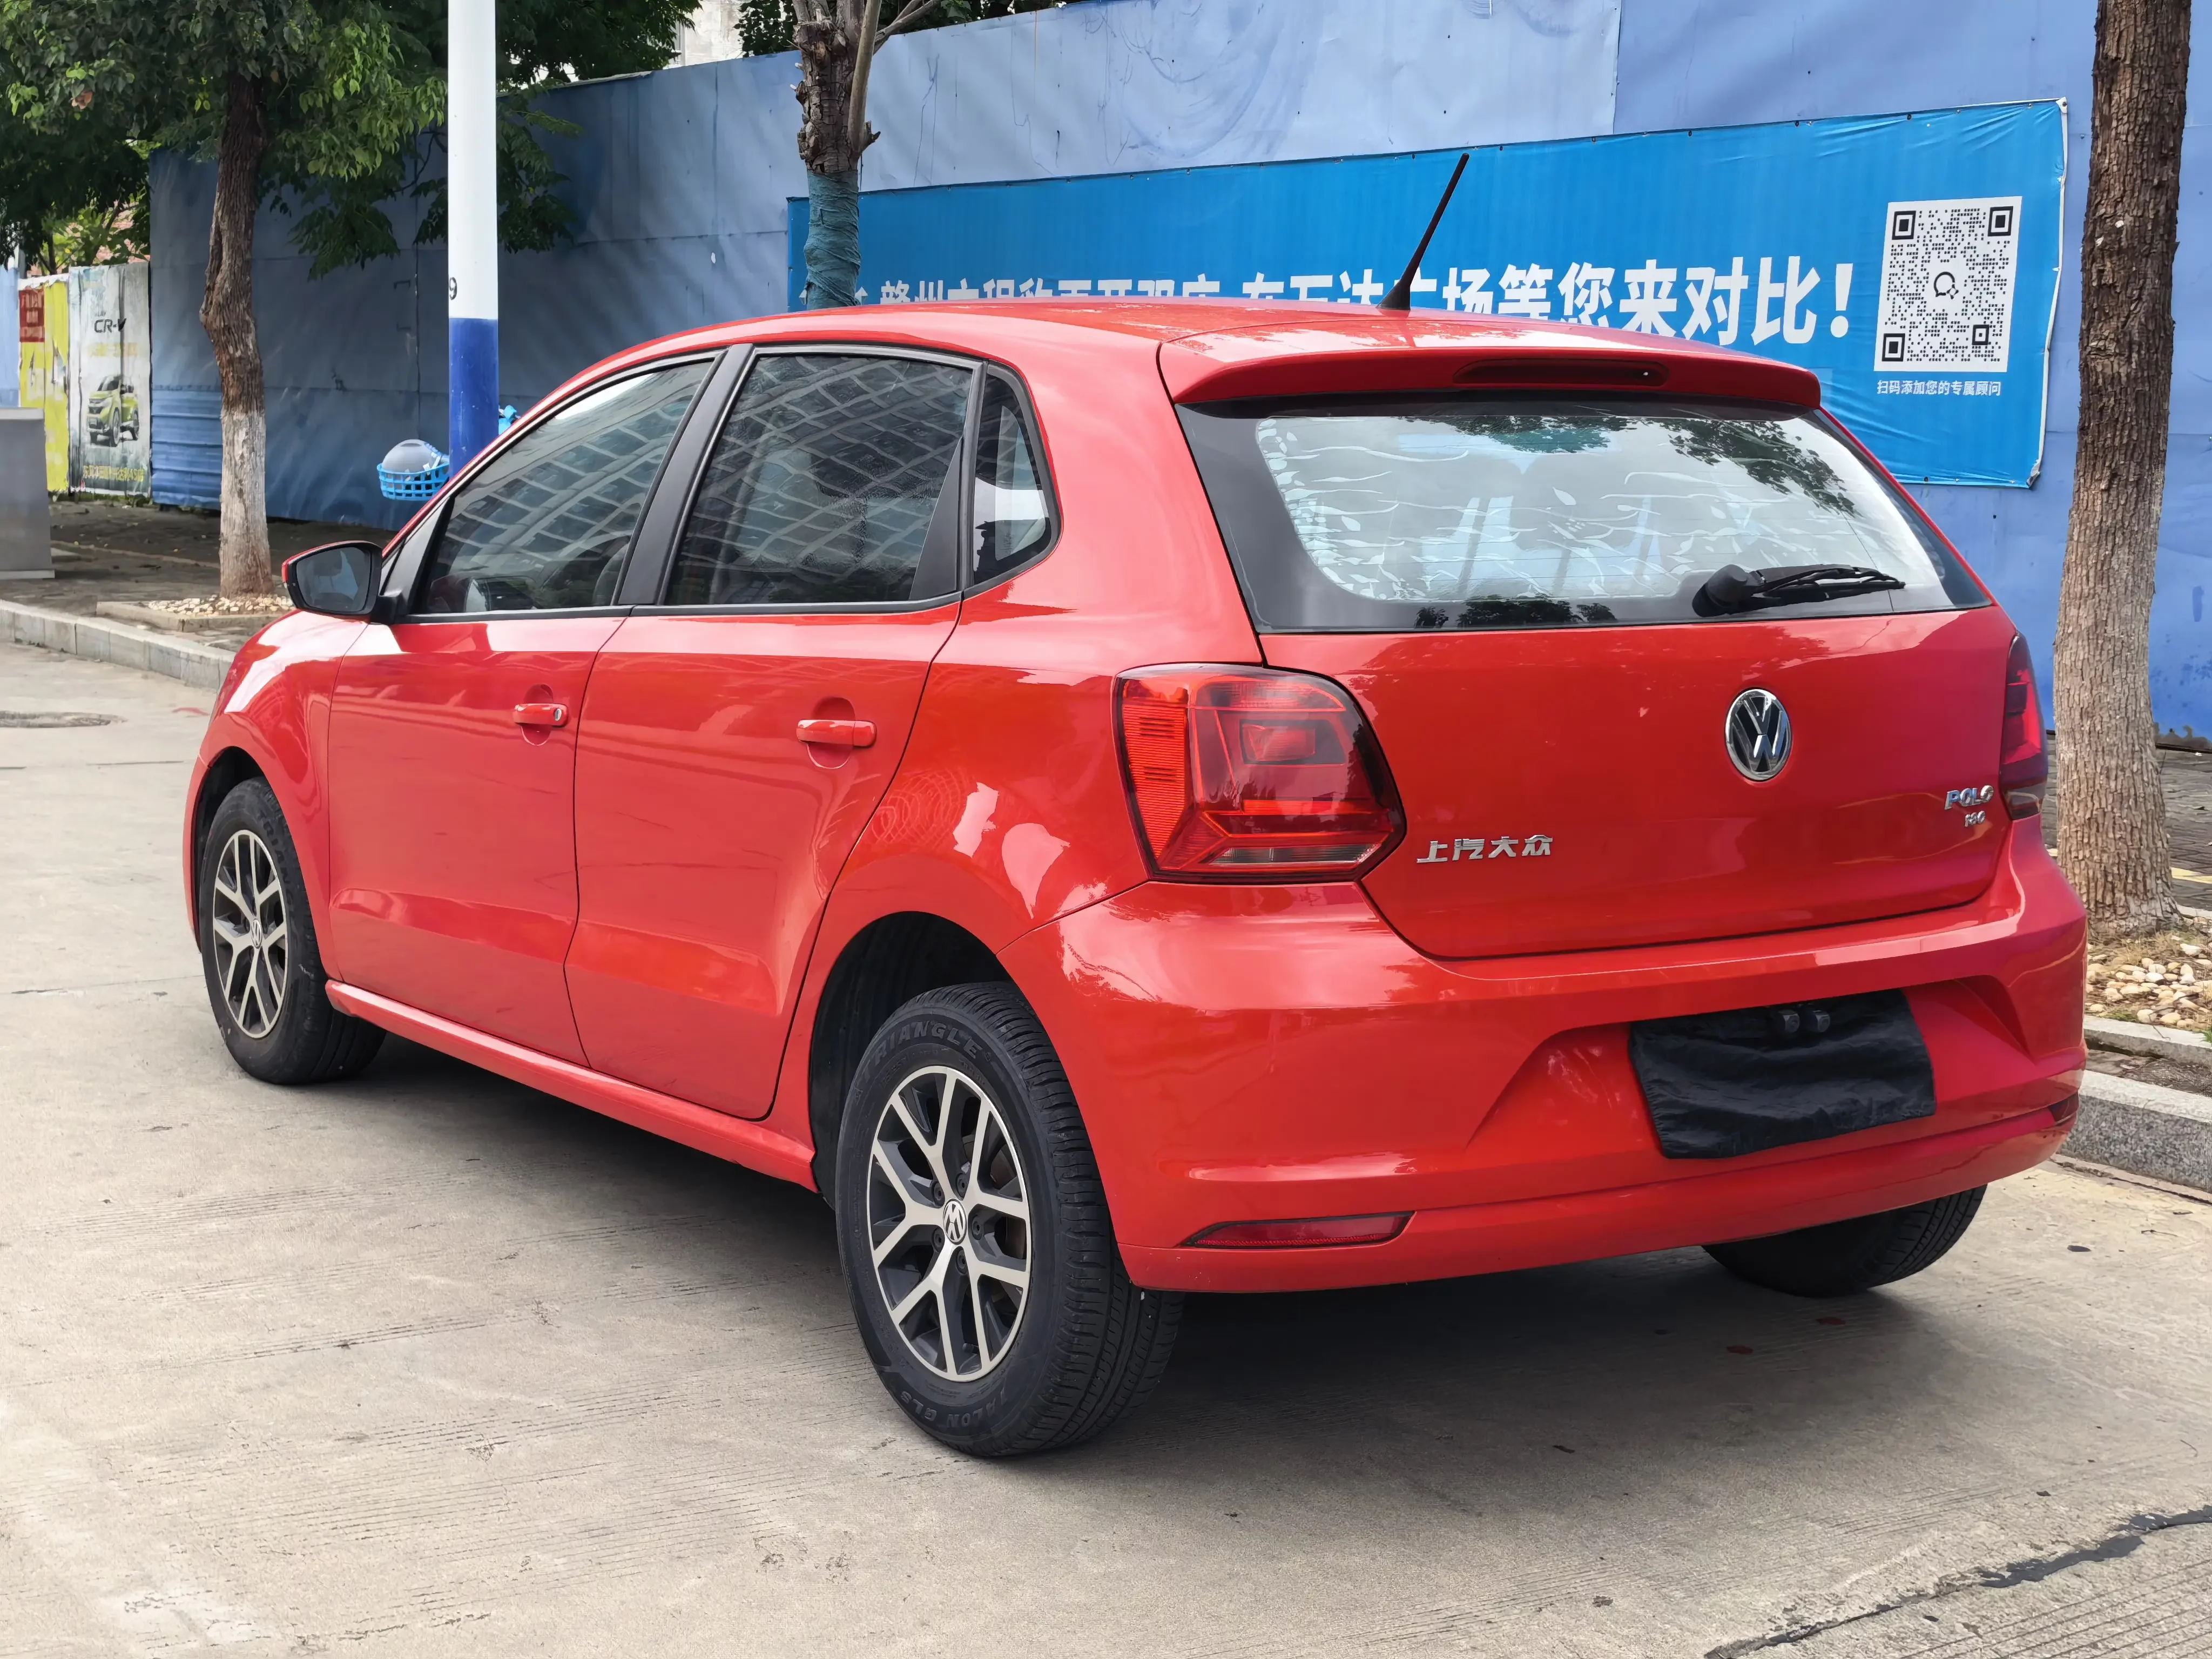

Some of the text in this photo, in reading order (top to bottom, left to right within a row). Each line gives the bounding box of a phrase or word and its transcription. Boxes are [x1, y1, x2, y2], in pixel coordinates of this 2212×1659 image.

[94, 318, 127, 333] CR-V
[1877, 380, 2001, 396] 扫码添加您的专属顾问
[1945, 785, 1994, 810] POLO
[1417, 834, 1553, 863] 上汽大众
[861, 1020, 983, 1081] TRIANGLE
